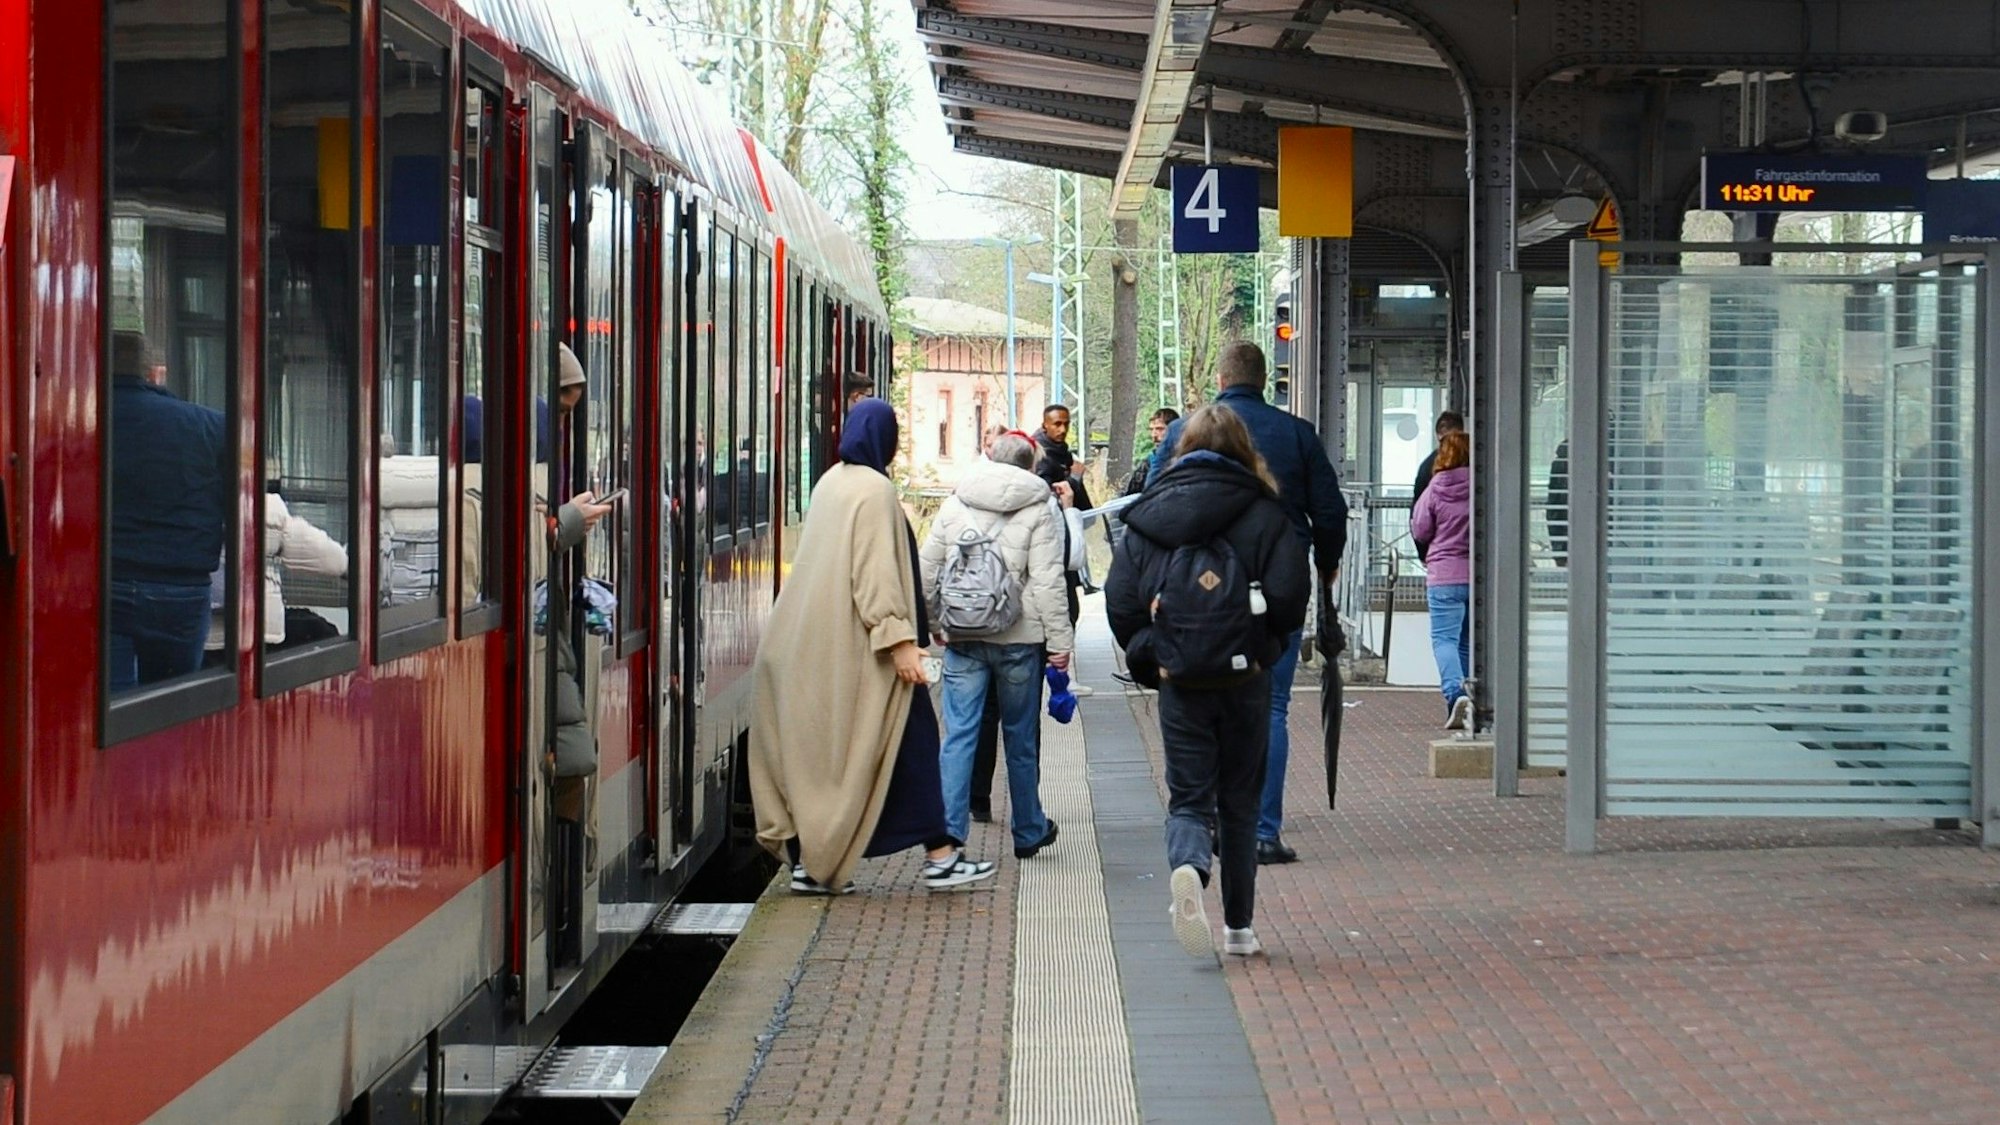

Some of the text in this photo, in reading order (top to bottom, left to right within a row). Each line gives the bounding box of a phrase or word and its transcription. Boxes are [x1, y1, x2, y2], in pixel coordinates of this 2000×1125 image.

[1755, 168, 1881, 183] Fahrgastinformation
[1184, 168, 1227, 233] 4
[1720, 184, 1814, 202] 11:31 Uhr
